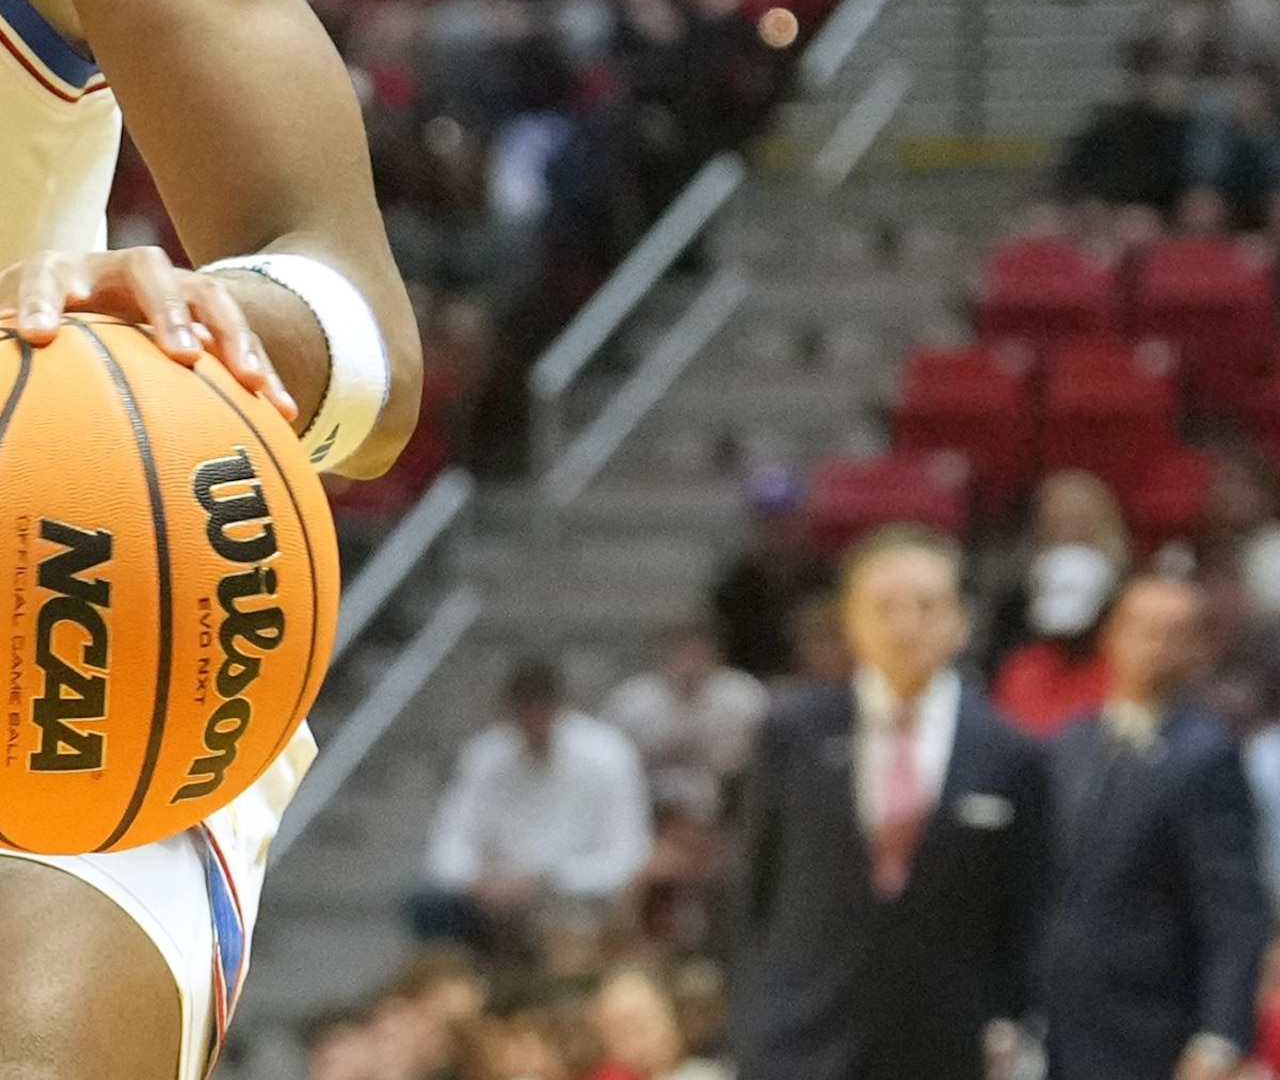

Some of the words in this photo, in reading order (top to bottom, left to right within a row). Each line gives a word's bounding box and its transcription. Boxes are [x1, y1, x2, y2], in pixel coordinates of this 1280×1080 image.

[11, 515, 29, 626] OFFICIAL
[27, 517, 114, 772] NCAA
[169, 444, 286, 804] Wilson
[197, 597, 212, 648] EVO
[8, 636, 26, 706] GAME
[194, 657, 211, 705] NXT
[5, 712, 22, 767] BALL
